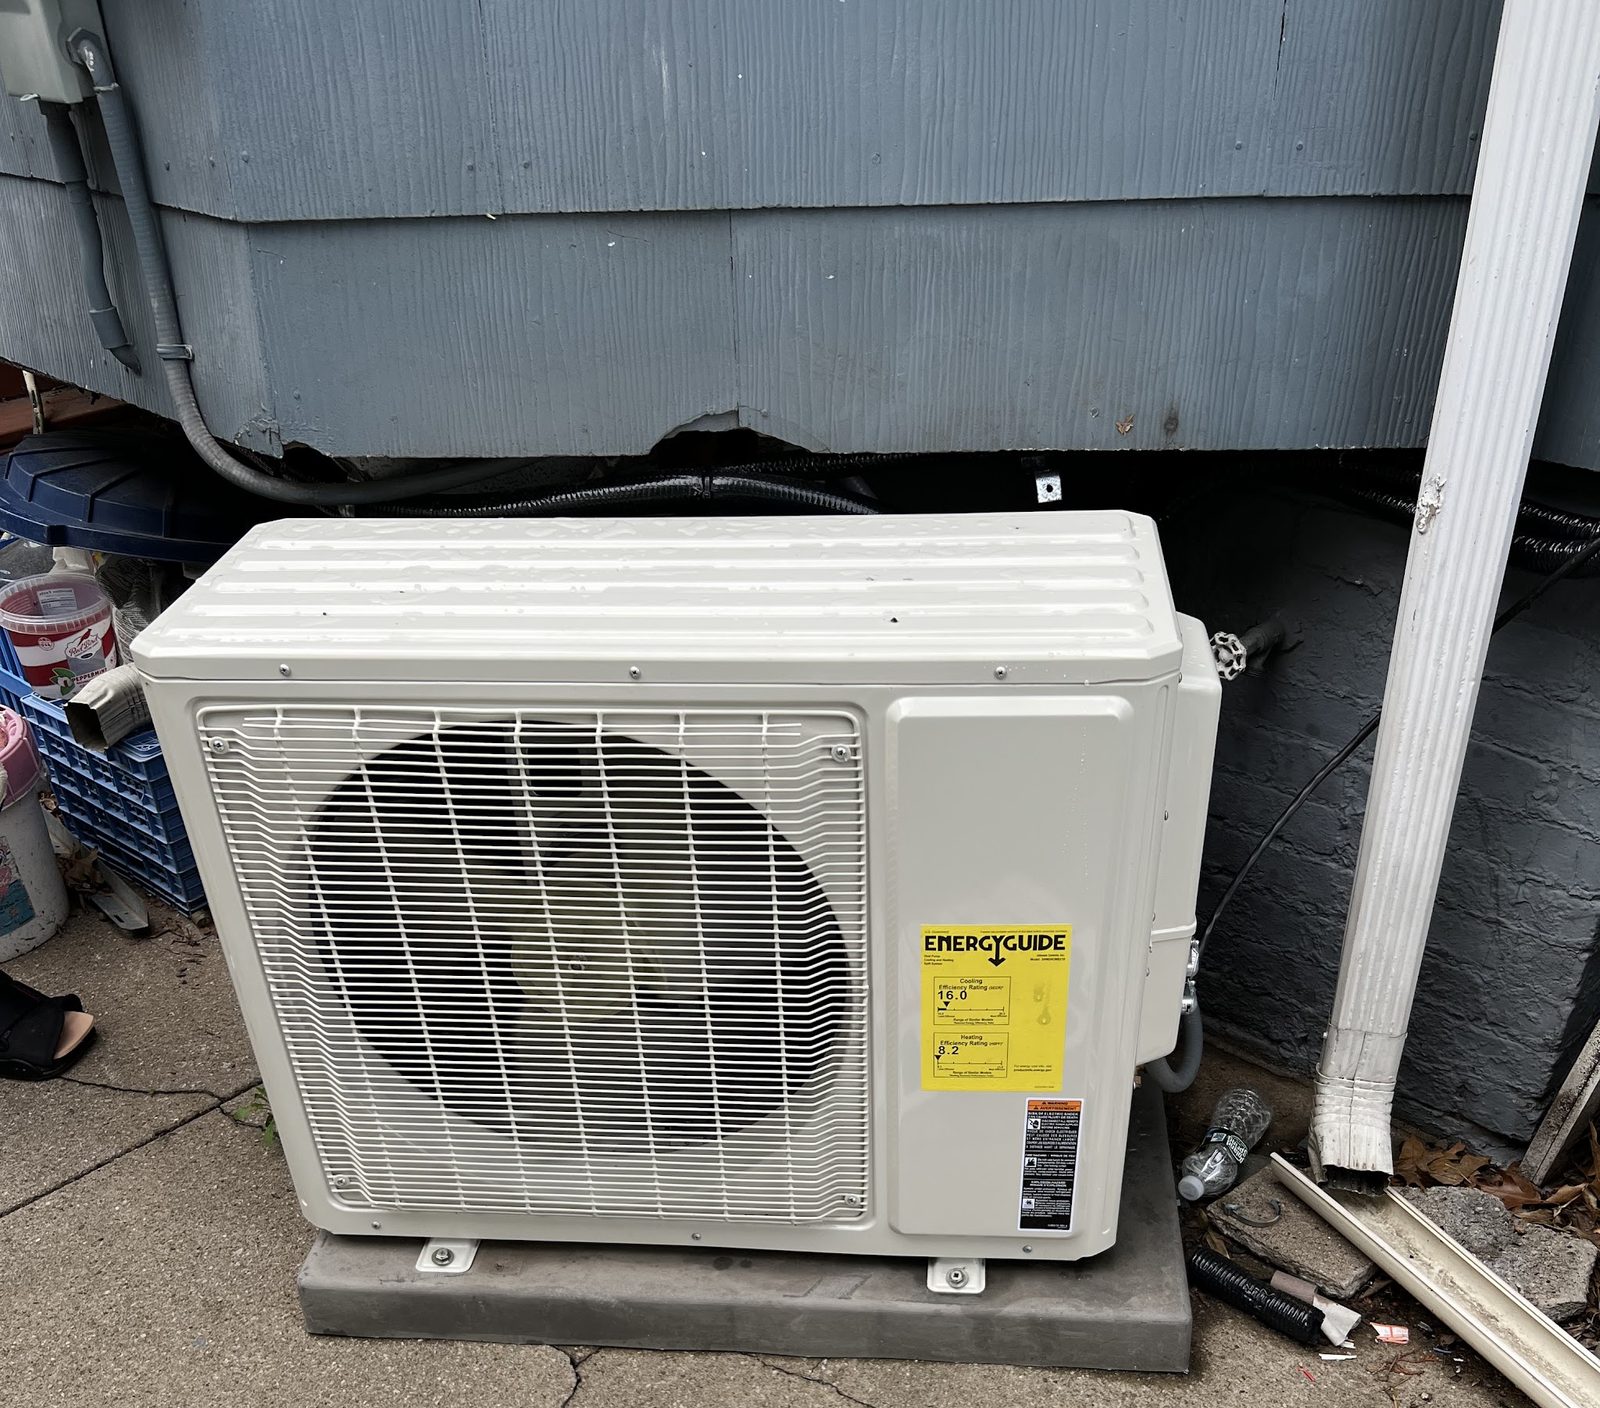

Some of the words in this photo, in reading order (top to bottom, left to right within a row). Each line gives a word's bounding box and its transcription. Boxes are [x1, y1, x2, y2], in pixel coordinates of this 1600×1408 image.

[925, 934, 1066, 956] ENERGYGUIDE
[938, 990, 967, 1000] 16.0
[938, 1046, 959, 1055] 8.2
